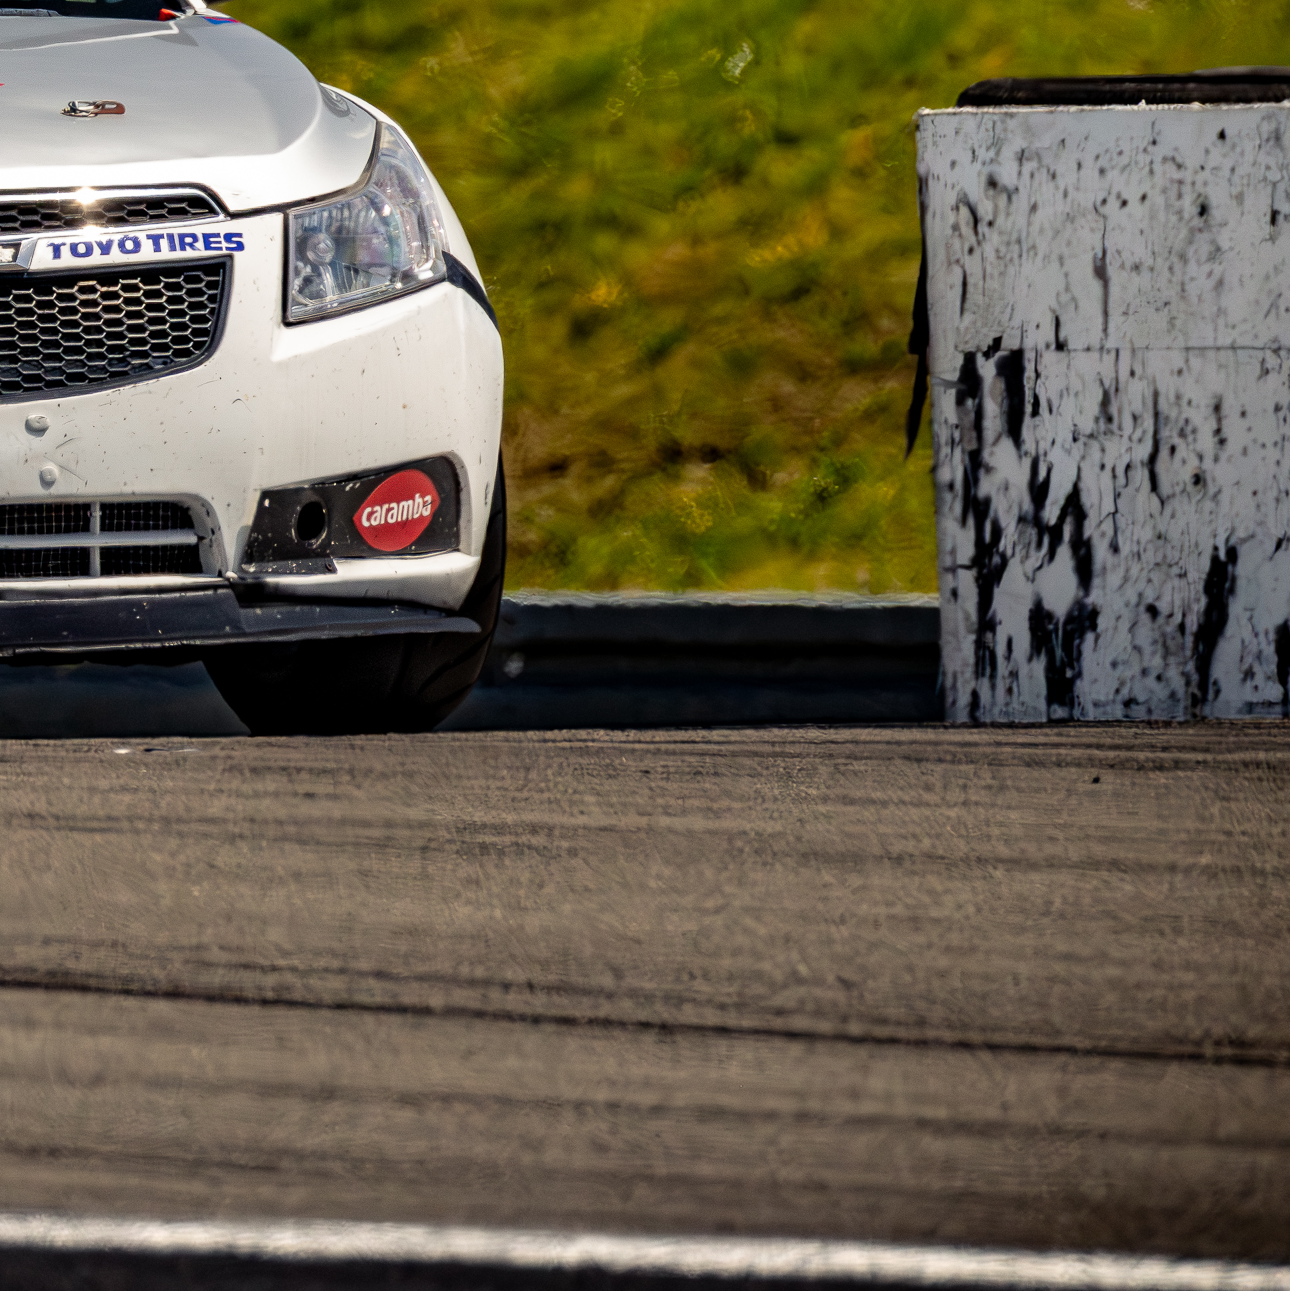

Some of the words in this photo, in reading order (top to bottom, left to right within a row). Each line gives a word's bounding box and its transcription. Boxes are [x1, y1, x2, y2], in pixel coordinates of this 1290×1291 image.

[46, 235, 142, 260] TOYO
[146, 232, 245, 253] TIRES
[361, 492, 433, 528] caramba
